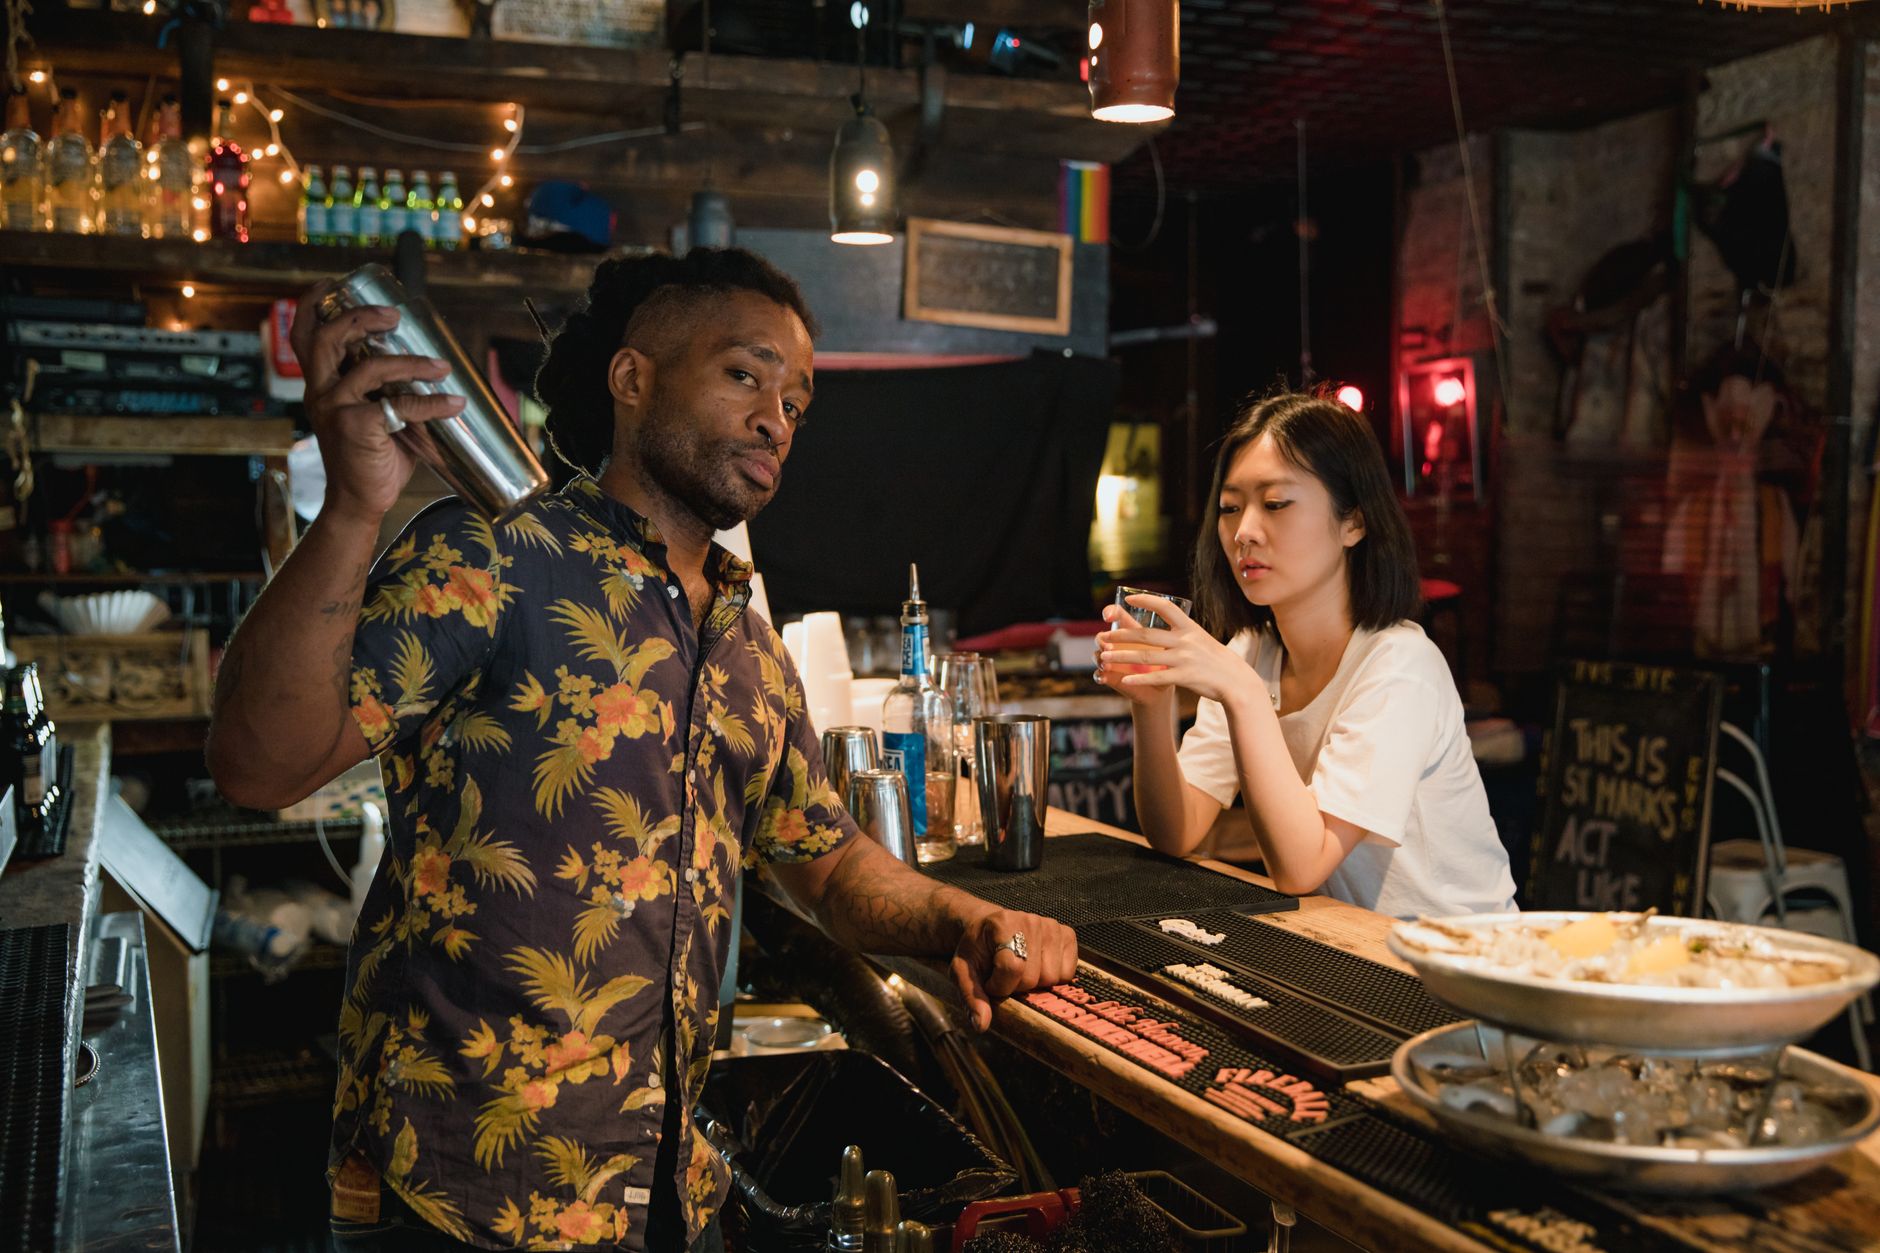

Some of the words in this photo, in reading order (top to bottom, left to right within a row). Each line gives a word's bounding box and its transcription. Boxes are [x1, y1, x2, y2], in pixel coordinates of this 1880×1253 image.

[1569, 718, 1631, 773] THIS
[1635, 735, 1668, 784] IS
[1561, 763, 1591, 807] ST
[1555, 814, 1618, 867] ACT
[1576, 867, 1641, 908] LIKE
[1117, 1038, 1195, 1079] HELL
